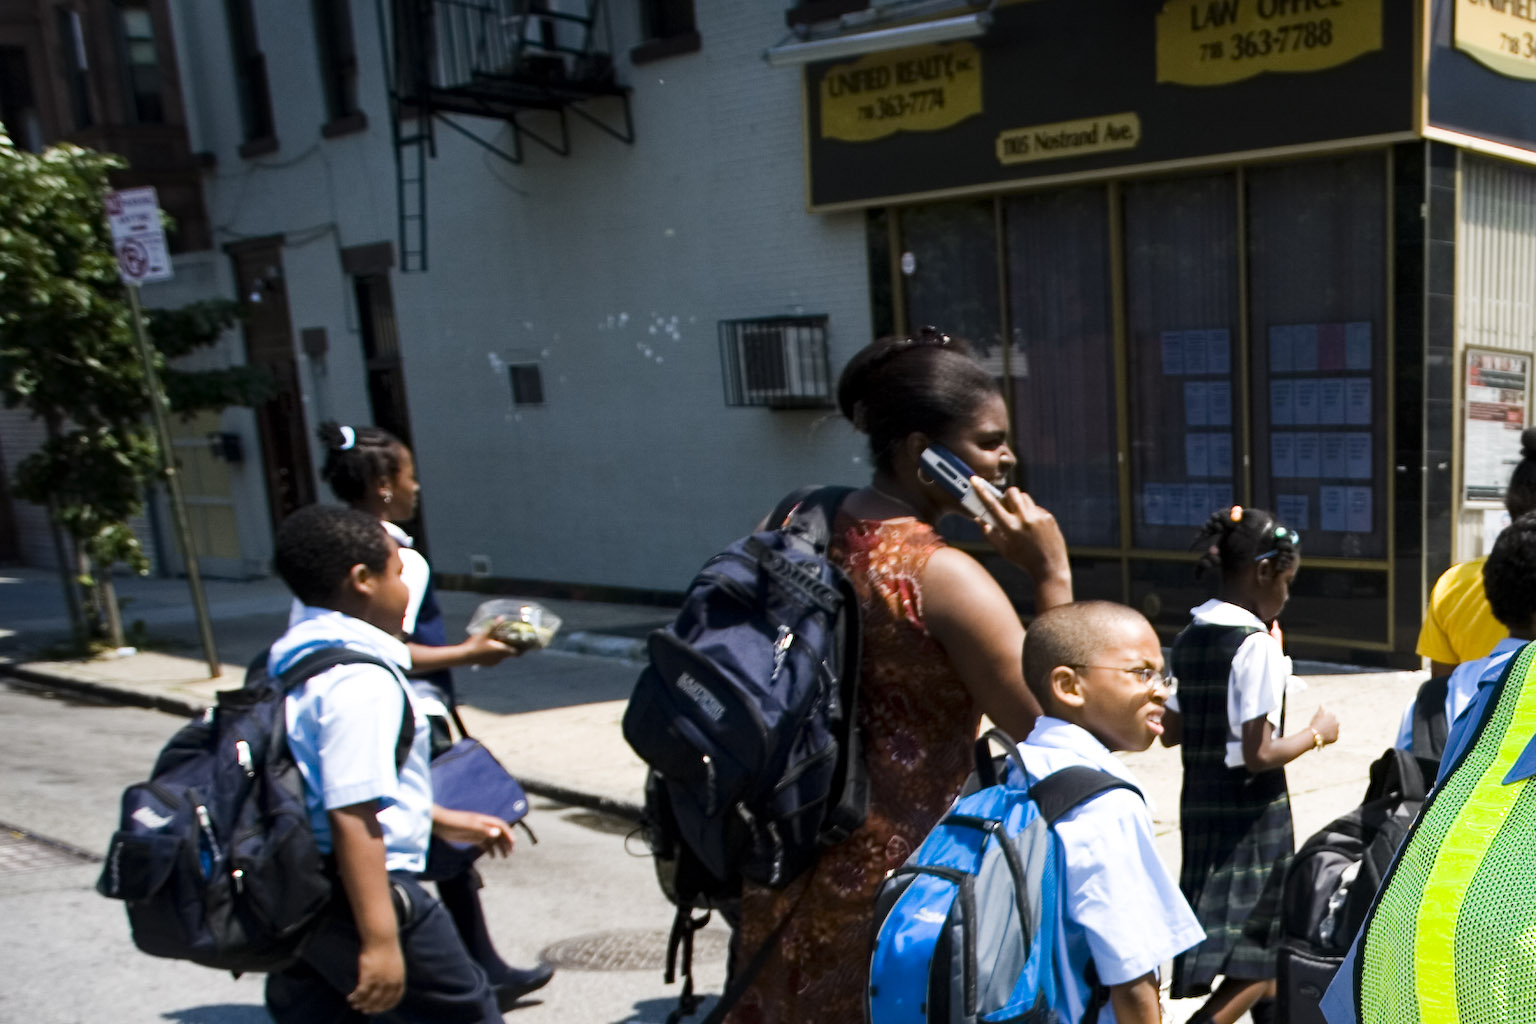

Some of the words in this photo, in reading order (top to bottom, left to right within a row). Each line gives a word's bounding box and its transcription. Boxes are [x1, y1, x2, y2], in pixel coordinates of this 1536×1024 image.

[1191, 0, 1238, 31] LAW
[1230, 18, 1333, 61] 363-7788
[827, 65, 890, 98] UNIFIED
[1034, 122, 1099, 151] Nostrand
